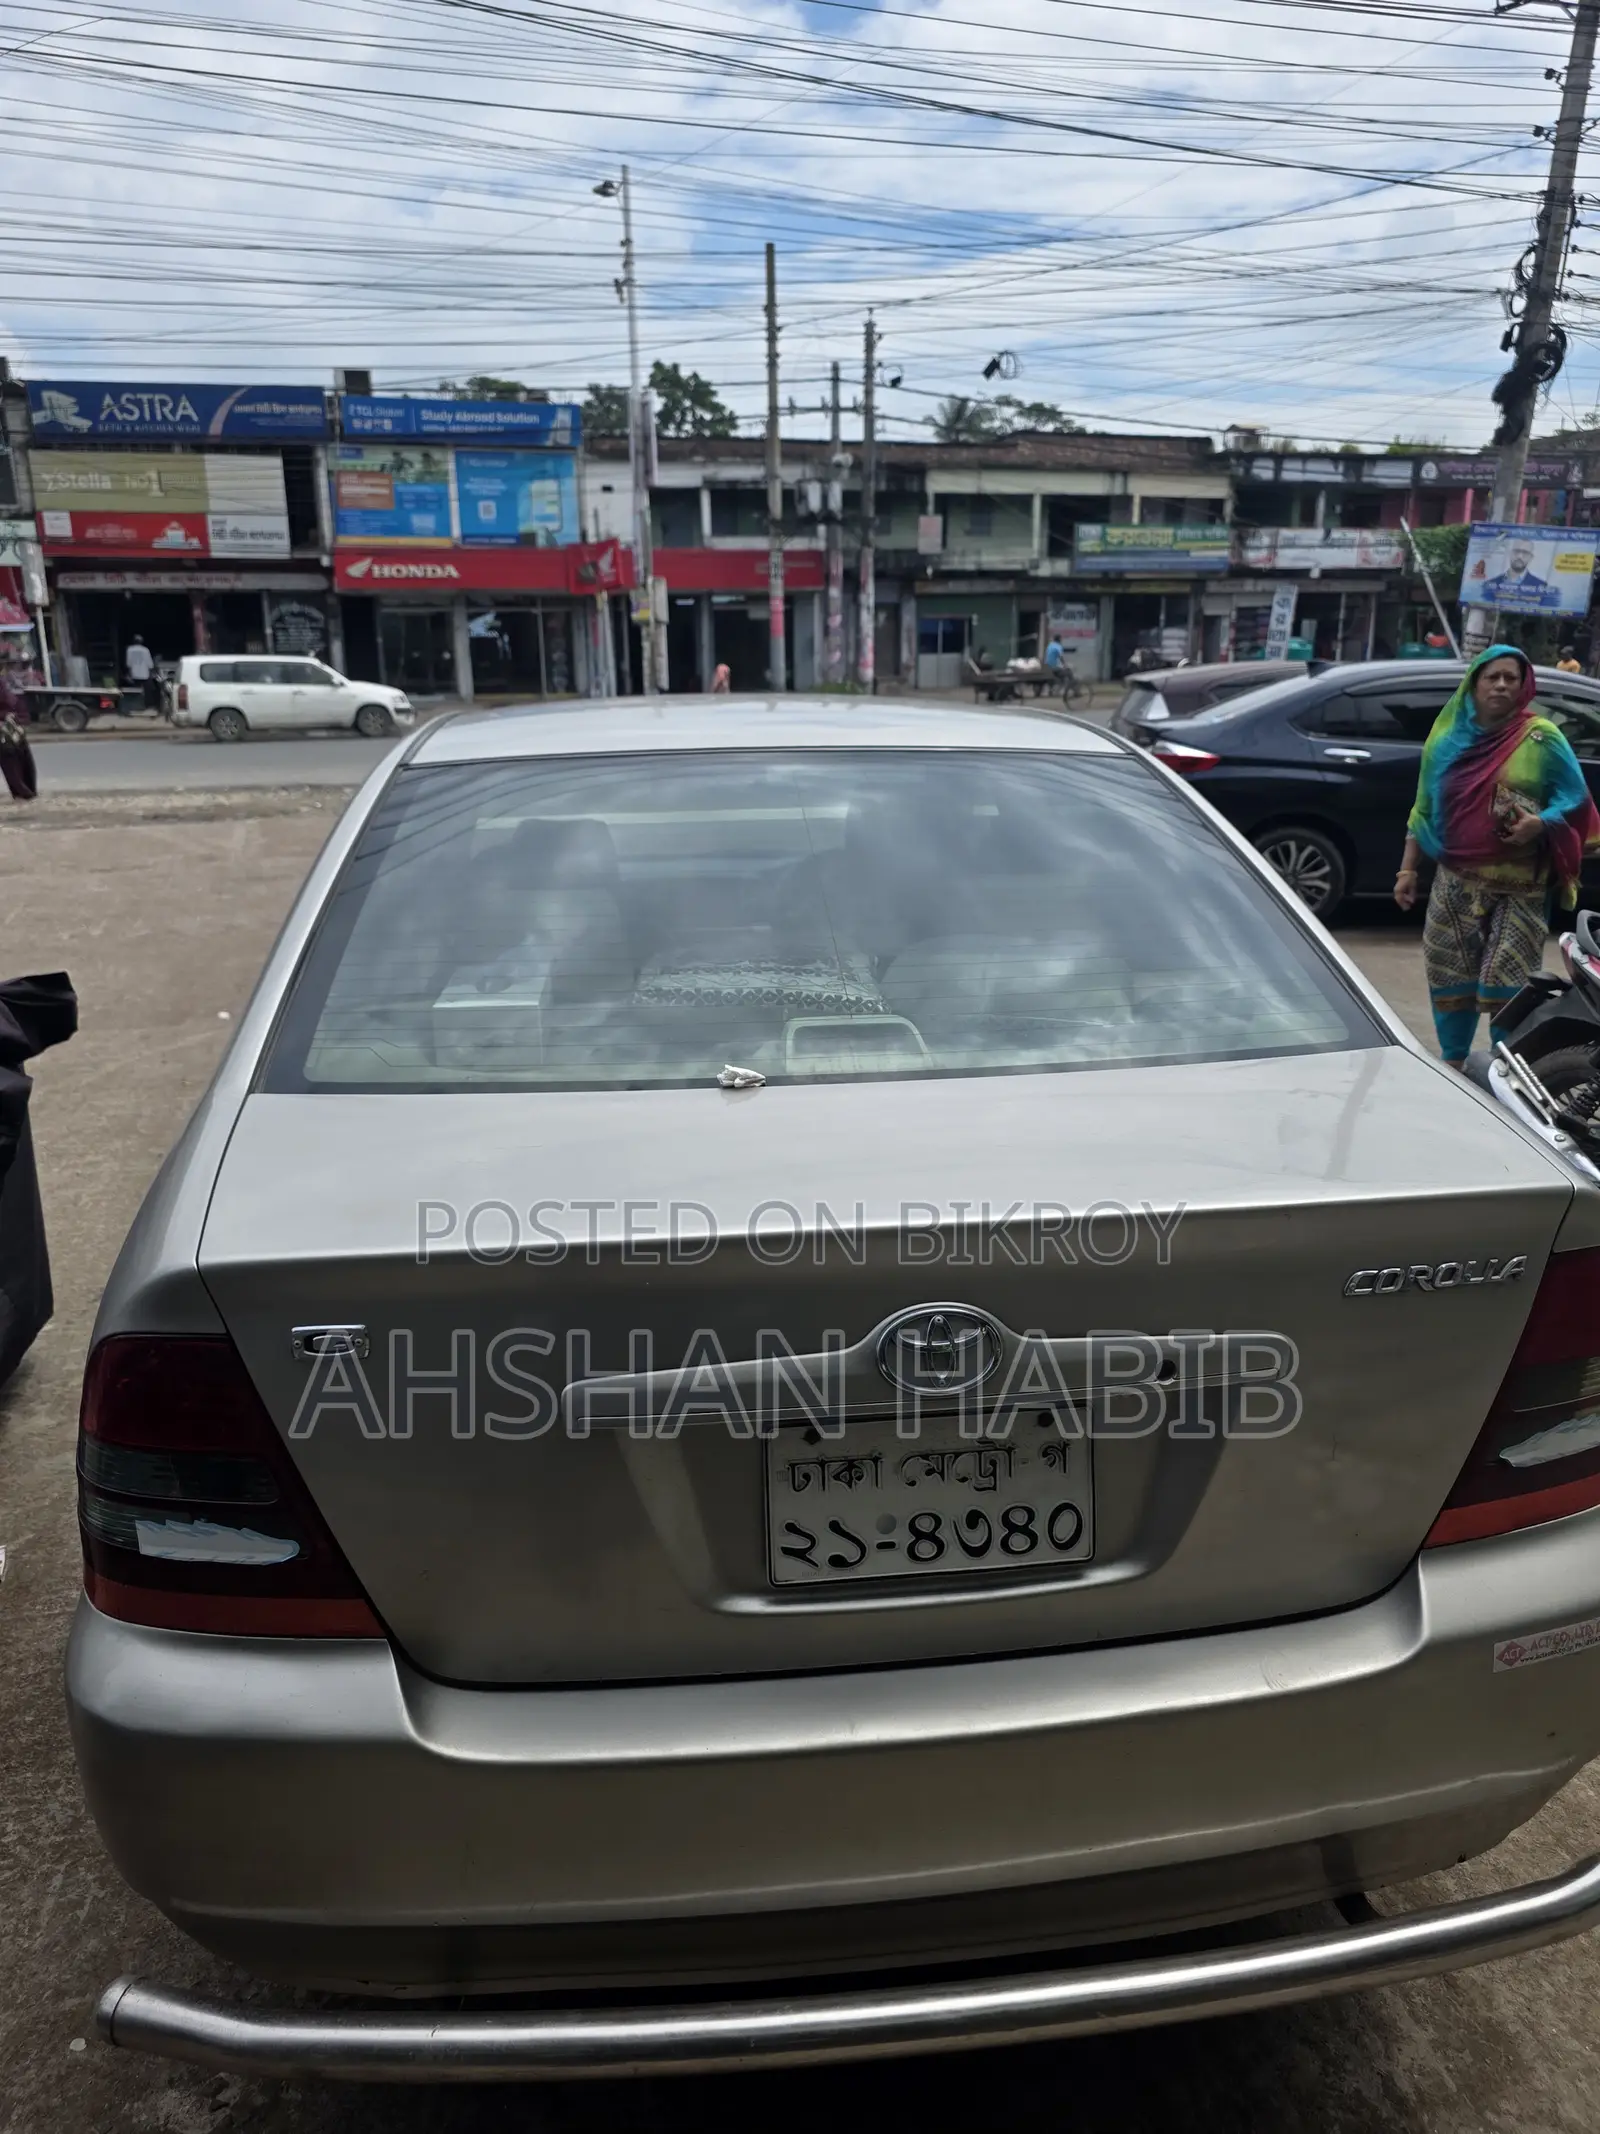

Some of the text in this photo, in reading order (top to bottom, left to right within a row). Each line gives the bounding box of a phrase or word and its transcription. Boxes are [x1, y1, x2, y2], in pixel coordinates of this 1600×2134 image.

[100, 393, 199, 422] ASTRA
[420, 408, 452, 423] Study
[497, 411, 540, 425] Solution
[371, 563, 460, 579] HONDA
[1343, 1255, 1528, 1296] COROLLA
[787, 1452, 884, 1493] ঢাকা
